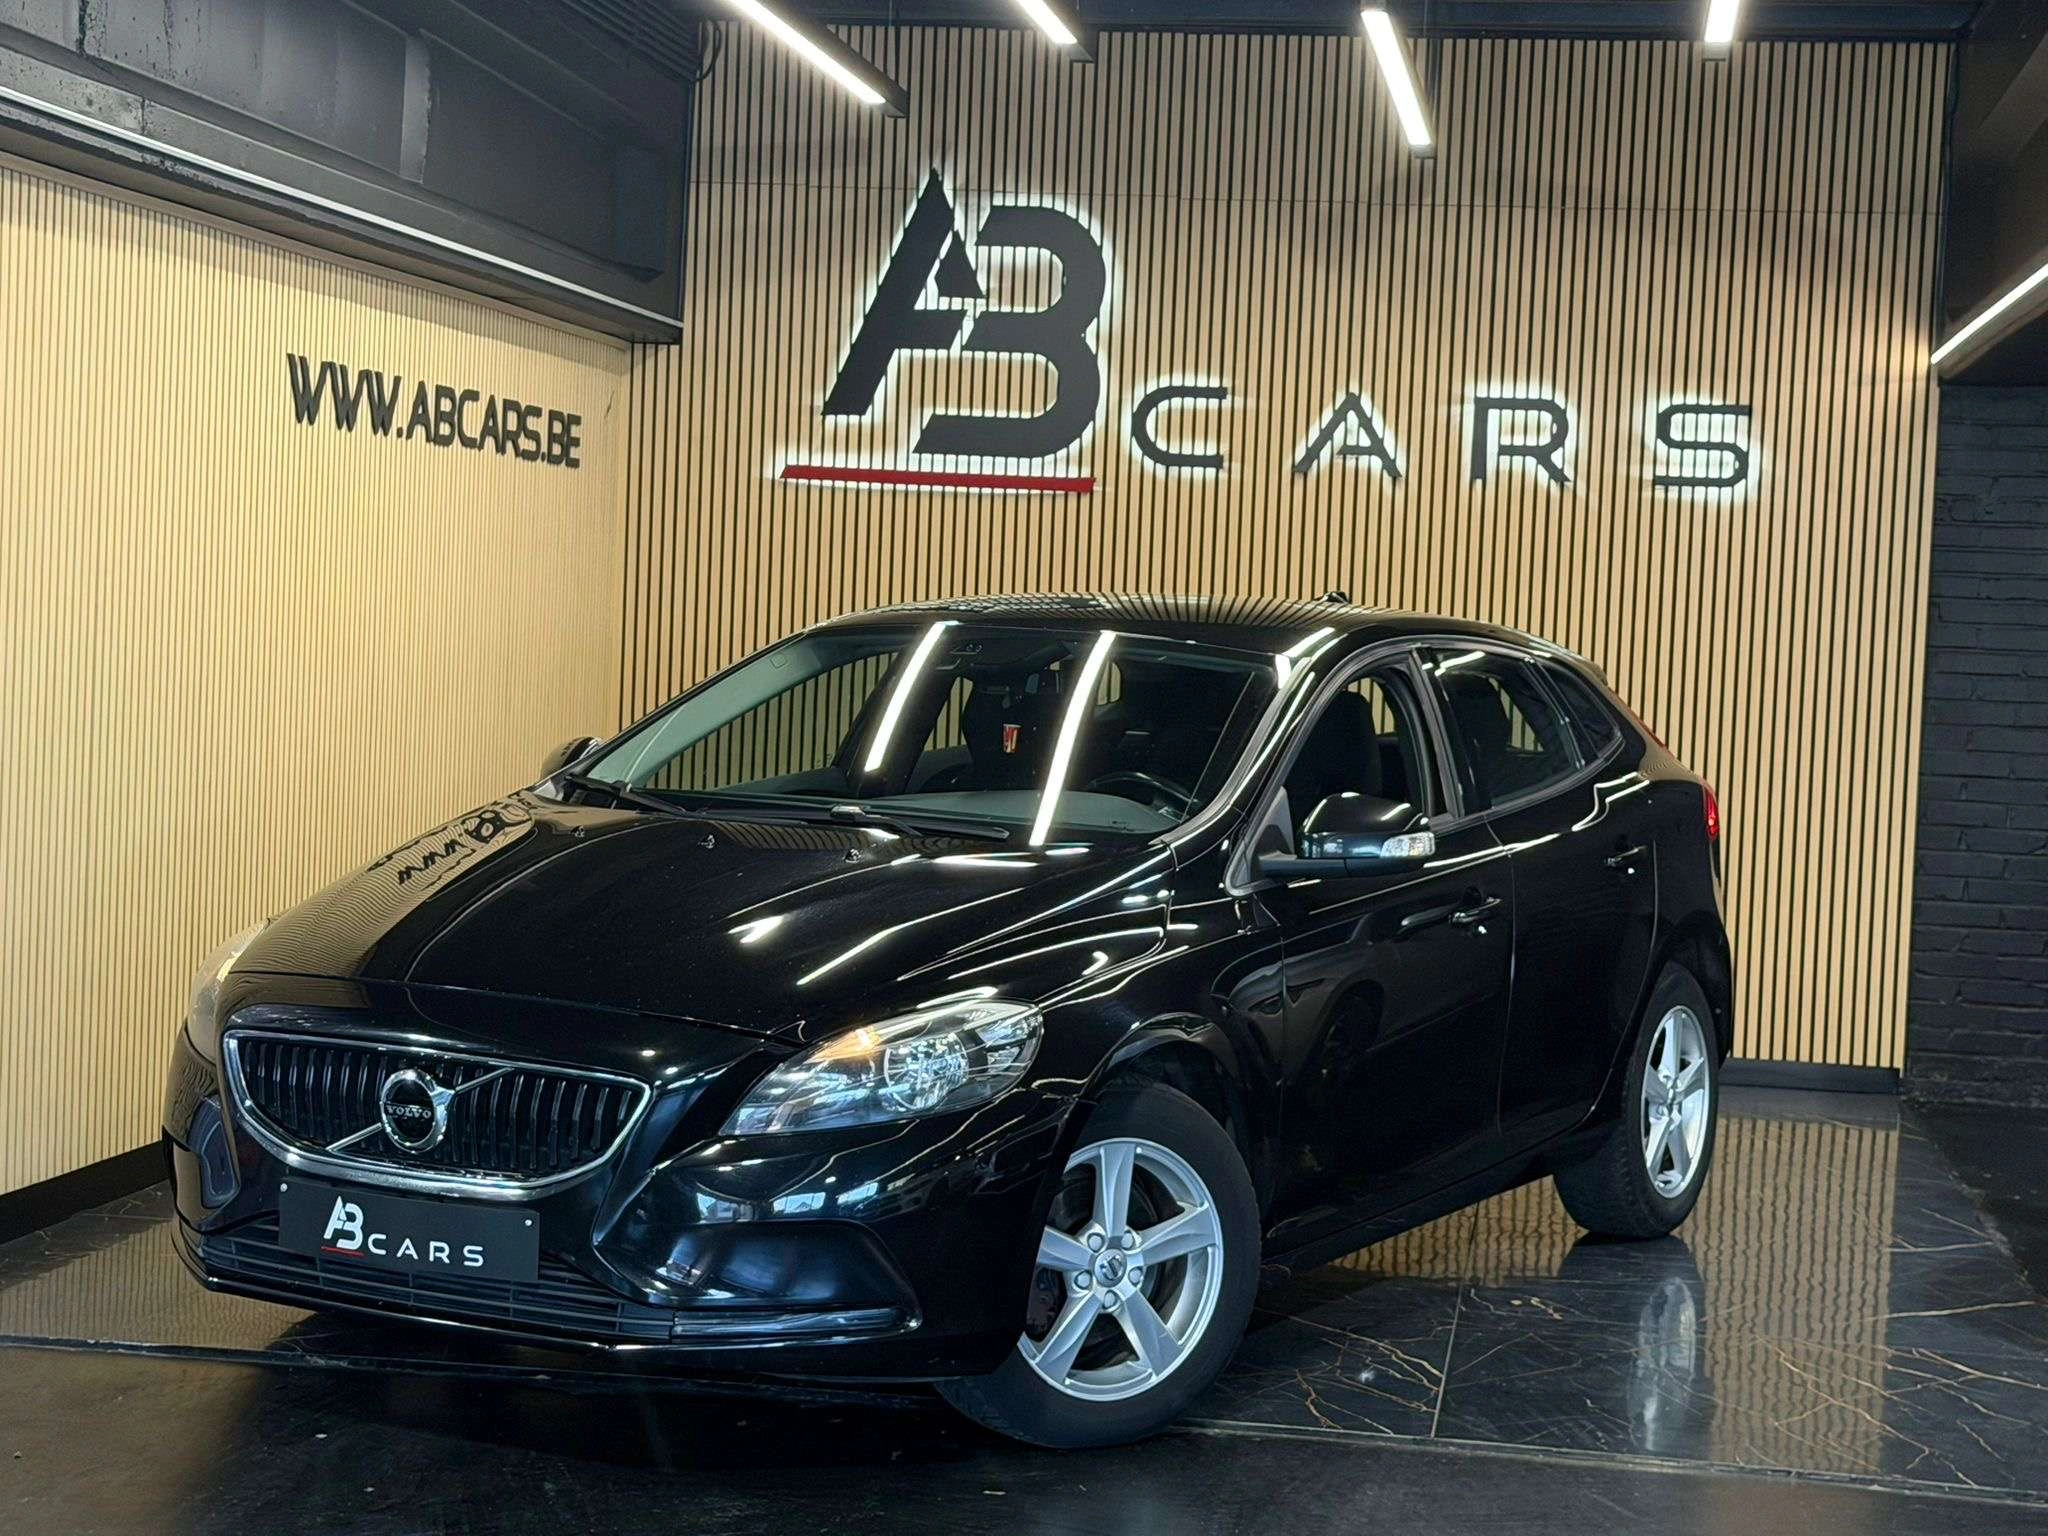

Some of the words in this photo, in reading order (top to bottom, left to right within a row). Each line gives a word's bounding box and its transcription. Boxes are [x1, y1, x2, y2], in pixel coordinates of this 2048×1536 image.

[821, 168, 1107, 457] AB
[1131, 386, 1752, 488] CARS
[287, 352, 582, 468] WWW.ABCARS.BE
[386, 1104, 432, 1119] VOLVO
[324, 1196, 363, 1250] AB
[367, 1233, 484, 1267] CARS
